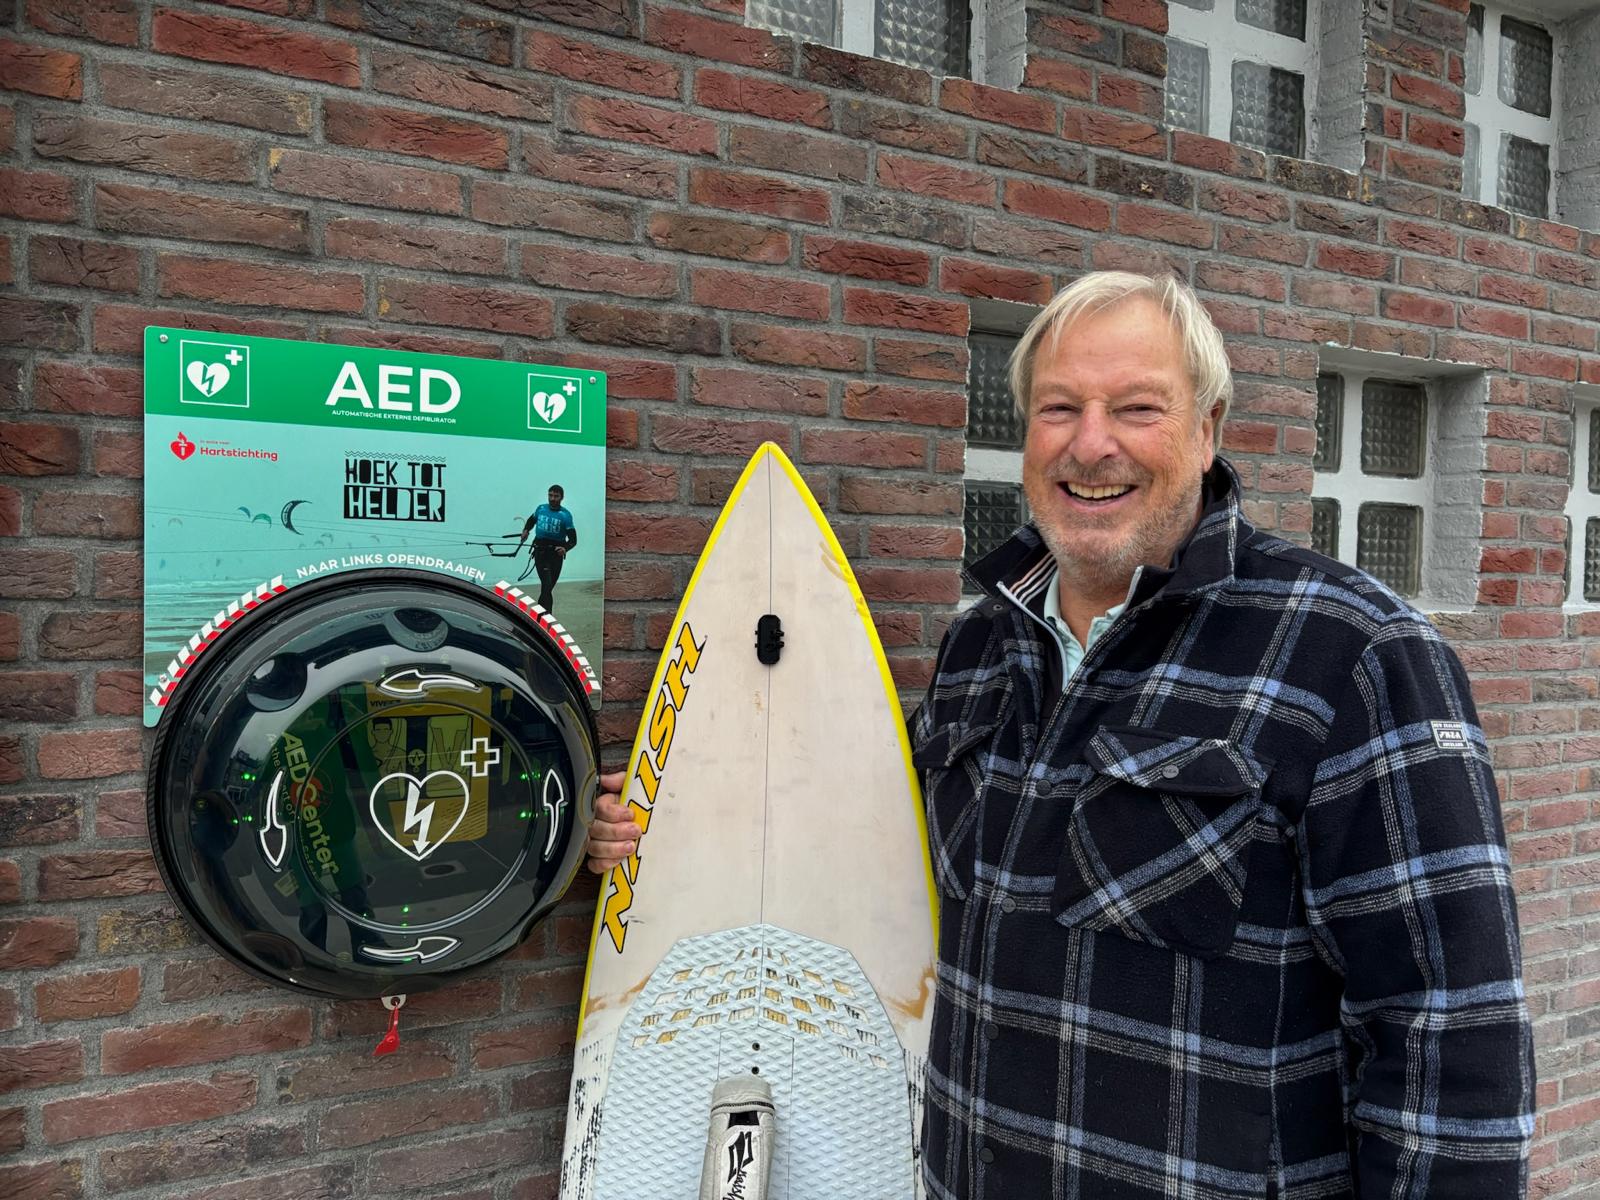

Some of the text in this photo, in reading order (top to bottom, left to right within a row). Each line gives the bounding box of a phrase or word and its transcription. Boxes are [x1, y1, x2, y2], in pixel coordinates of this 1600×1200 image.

[325, 361, 461, 414] AED
[332, 409, 382, 419] AUTOMATISCHE
[383, 413, 411, 421] EXTERNE
[200, 447, 278, 461] Hartstichting
[345, 459, 447, 488] HOEK TOT
[348, 486, 443, 520] HELDER
[296, 553, 486, 582] NAAR LINKS OPENDRAAIEN
